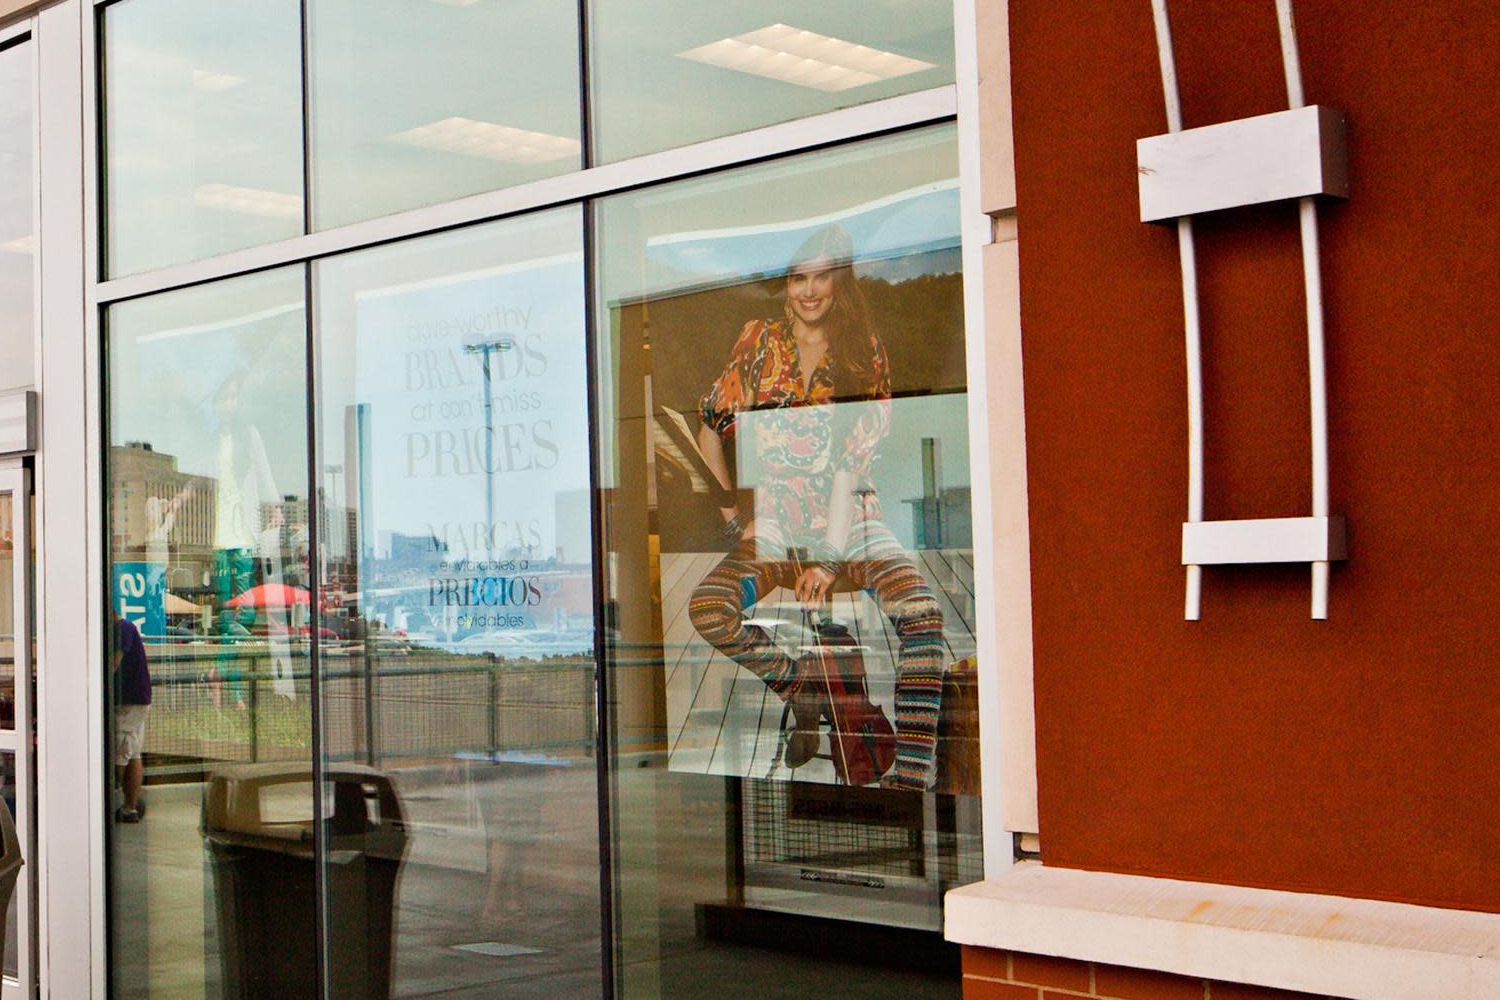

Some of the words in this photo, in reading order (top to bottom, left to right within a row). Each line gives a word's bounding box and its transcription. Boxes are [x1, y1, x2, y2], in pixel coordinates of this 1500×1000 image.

[410, 398, 433, 422] at
[402, 418, 561, 479] PRICES
[425, 519, 542, 553] MARCAS
[439, 559, 516, 572] evidiables
[428, 576, 542, 607] PRECIOS
